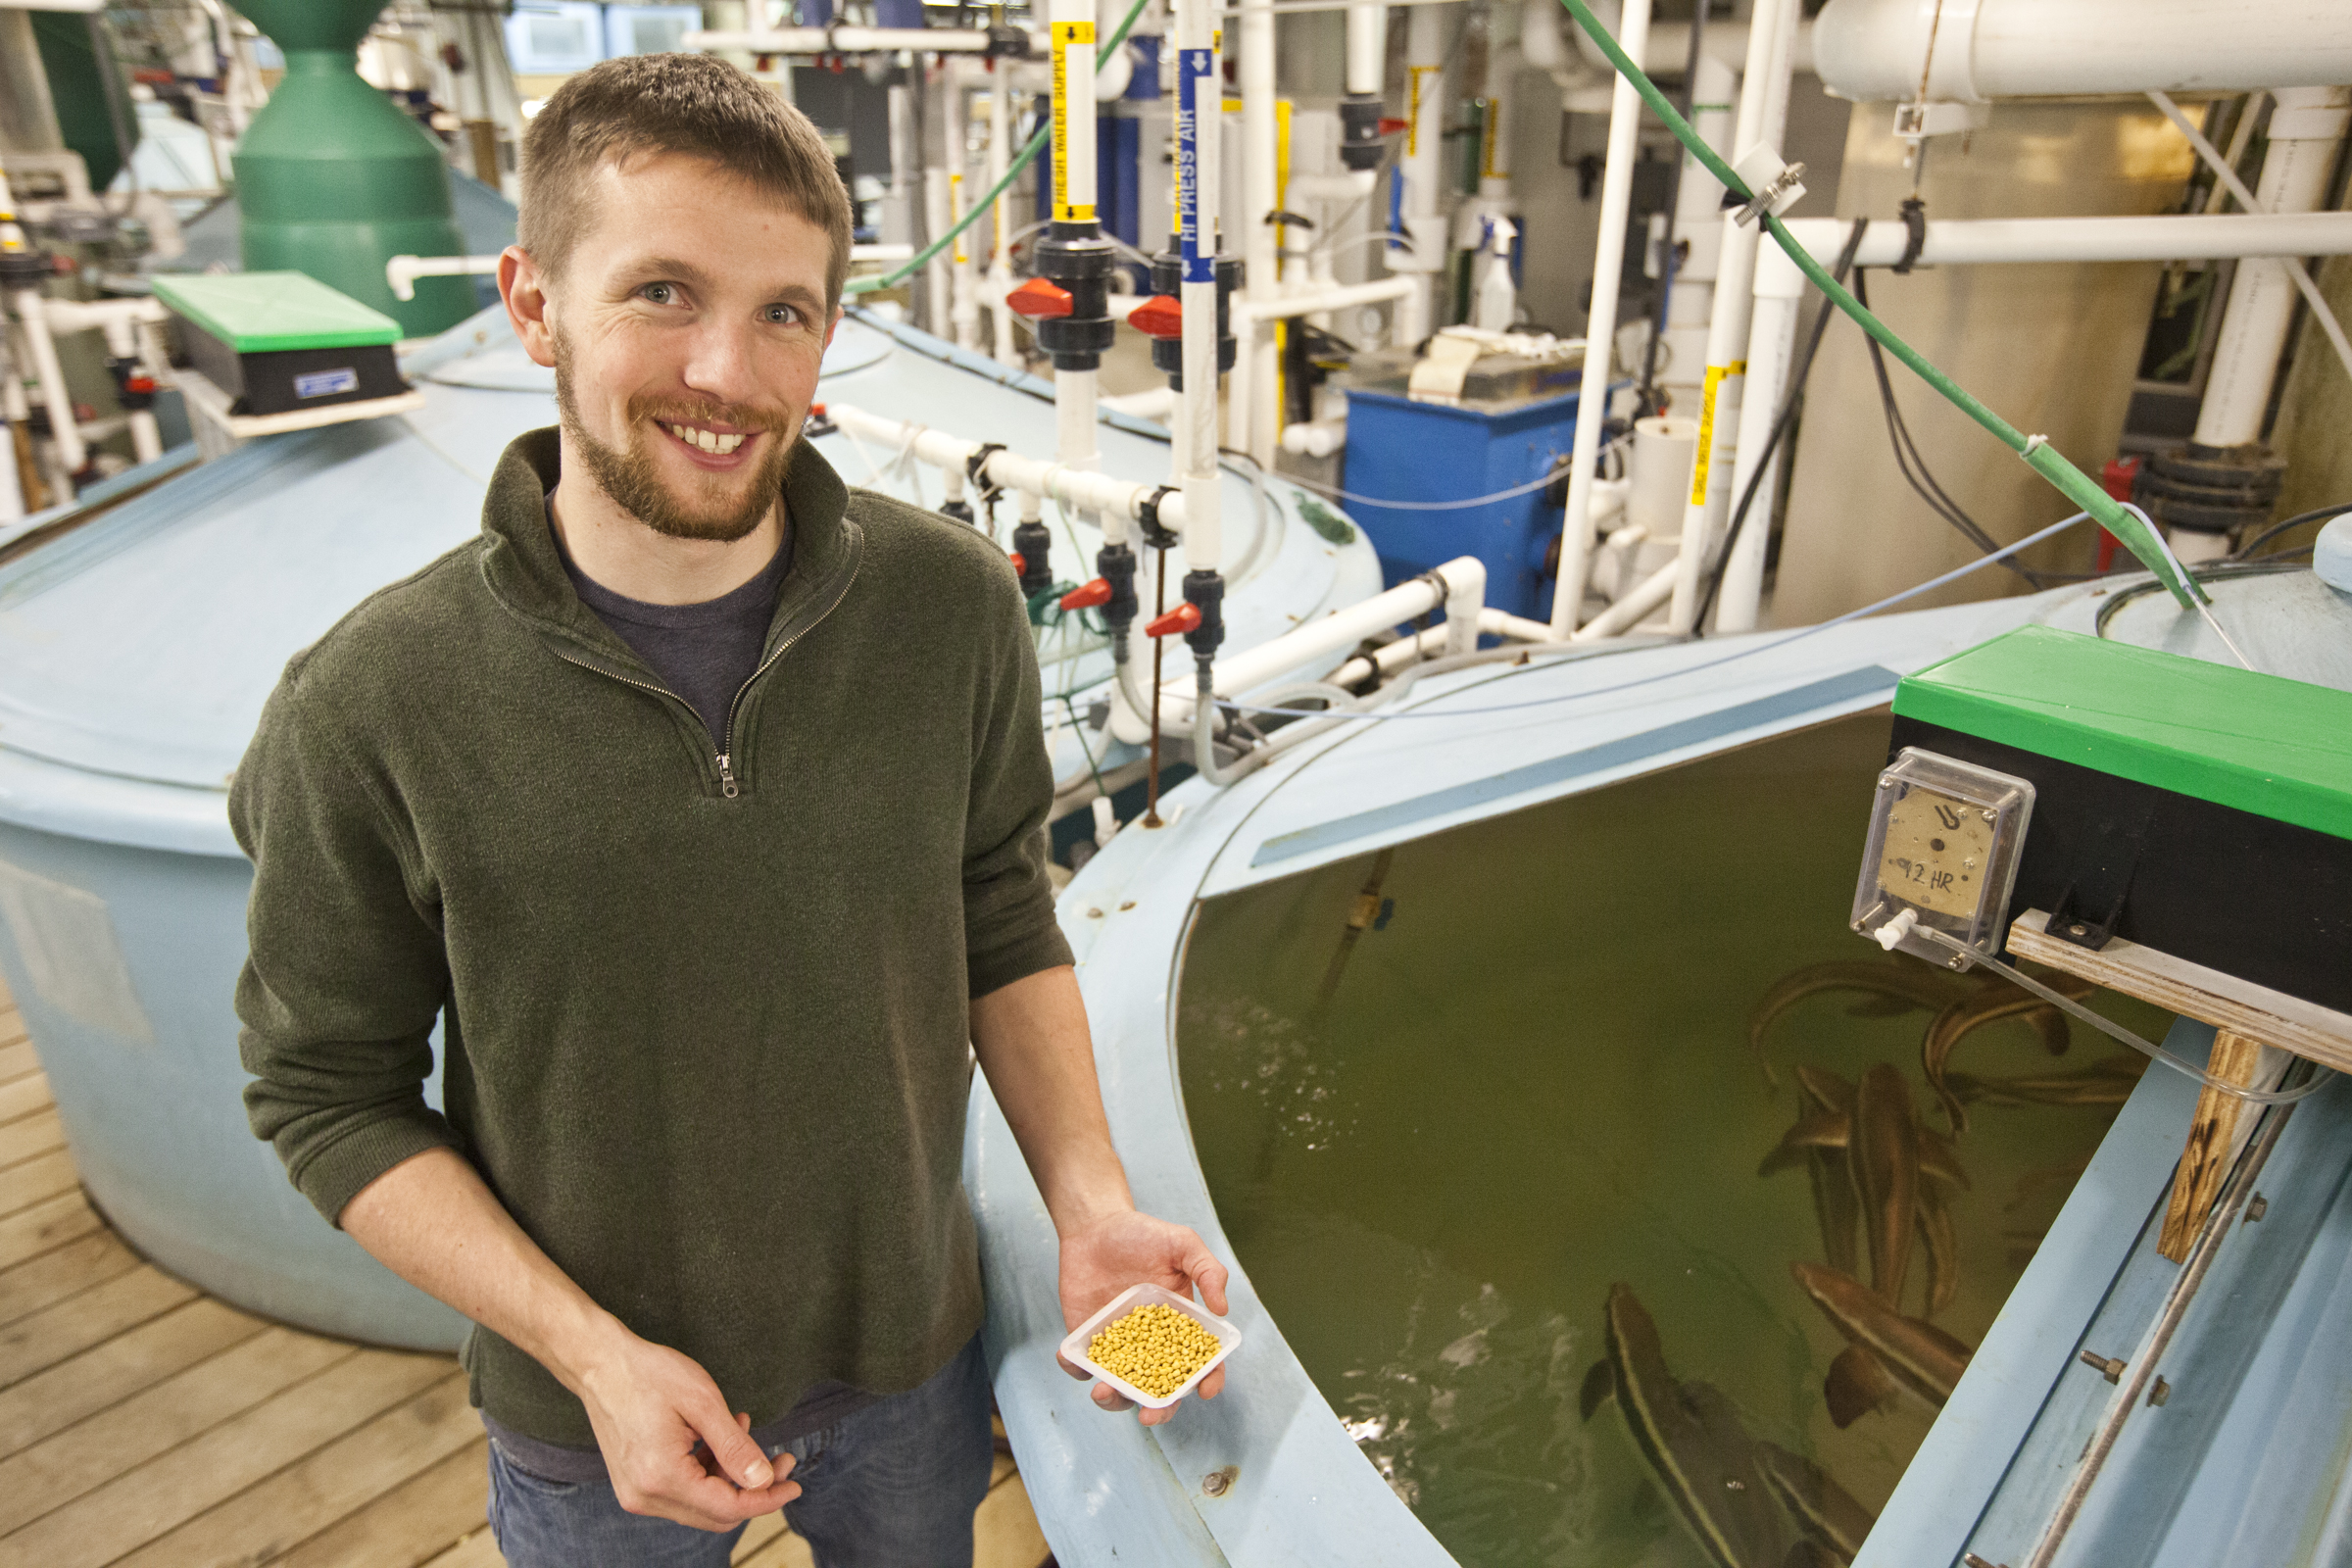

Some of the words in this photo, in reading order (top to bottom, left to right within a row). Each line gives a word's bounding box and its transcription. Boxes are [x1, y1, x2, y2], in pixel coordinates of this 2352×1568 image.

[1052, 49, 1066, 101] SUPPLY
[1052, 108, 1066, 153] WATER
[1179, 109, 1195, 142] AIR
[1052, 160, 1067, 204] FRESH
[1179, 150, 1196, 216] PRESS
[1180, 222, 1197, 242] HI
[1931, 870, 1953, 894] HR
